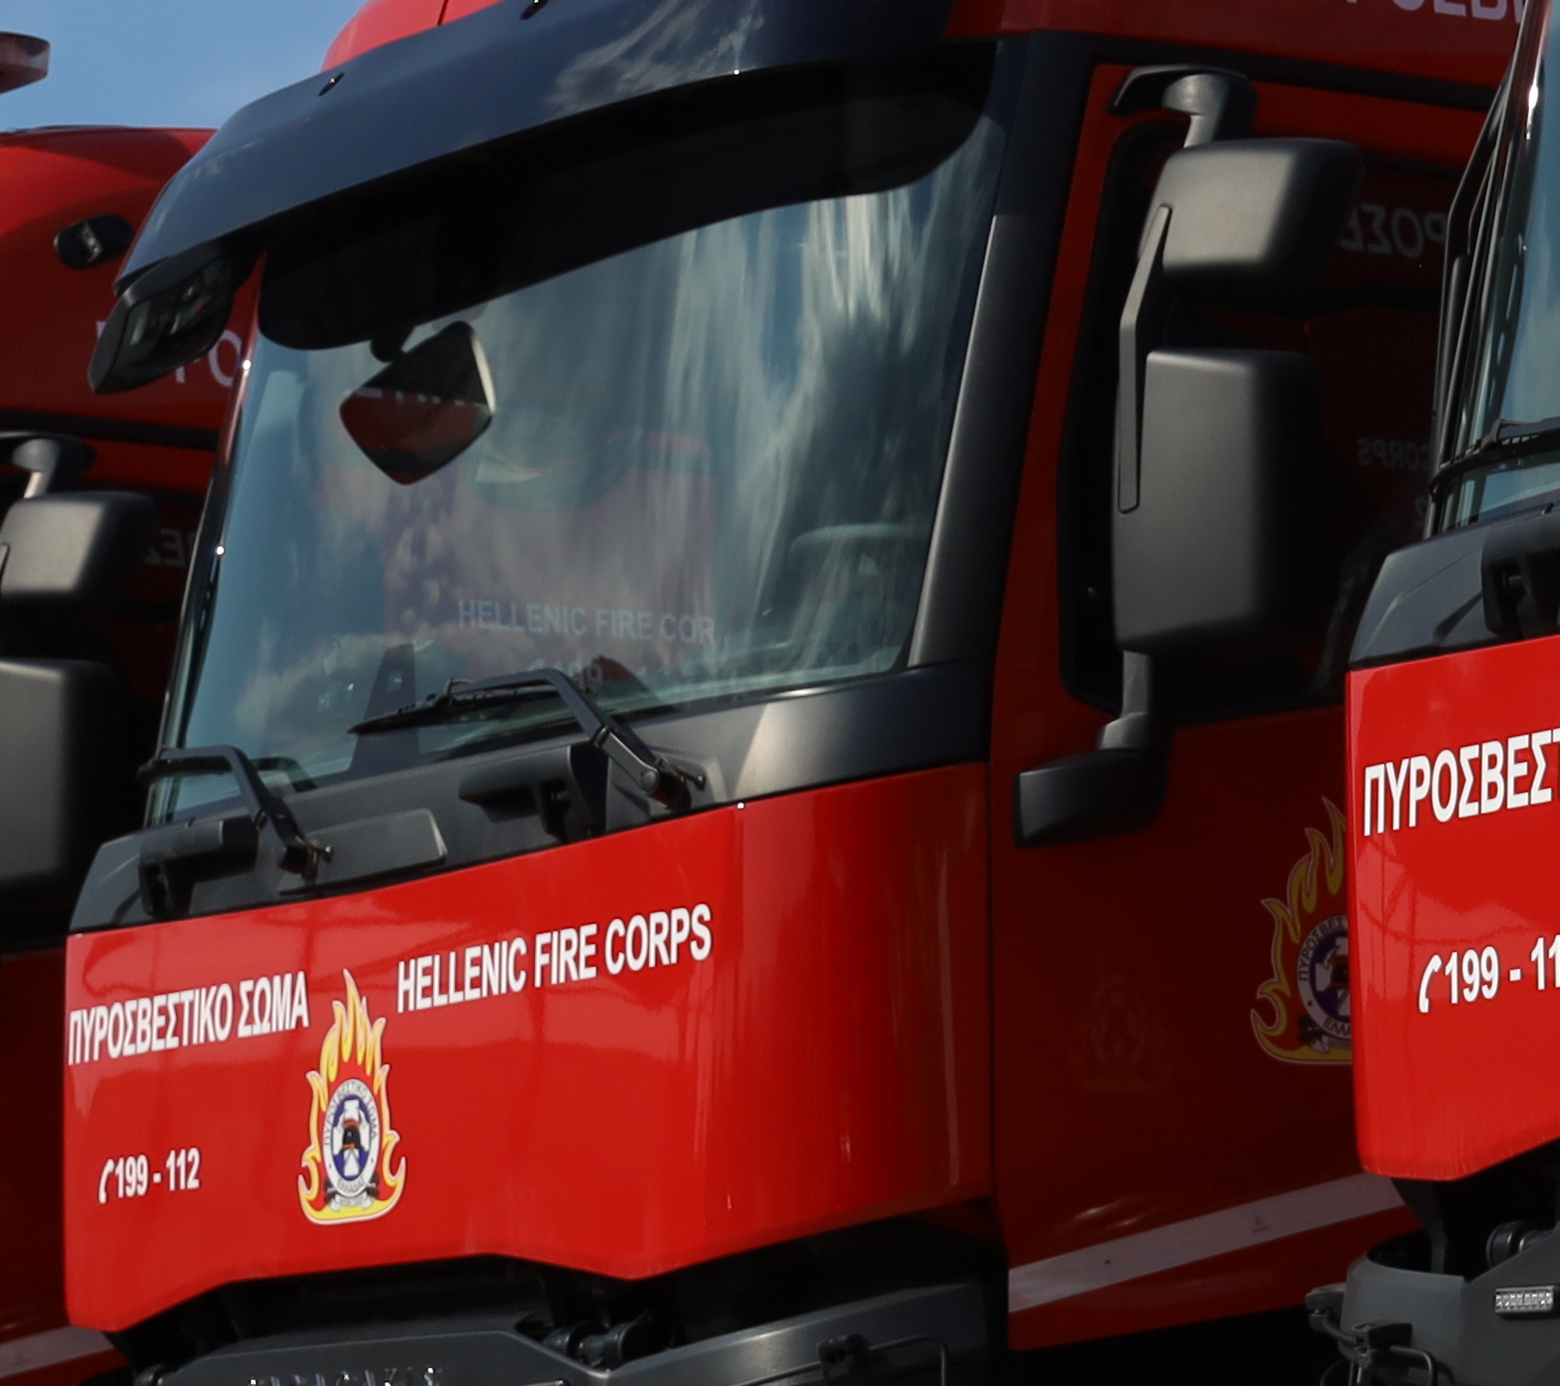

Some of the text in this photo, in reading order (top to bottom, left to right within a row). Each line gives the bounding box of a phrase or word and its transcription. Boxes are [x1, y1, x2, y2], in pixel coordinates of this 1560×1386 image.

[595, 608, 654, 641] FIRE
[397, 903, 712, 1013] HELLENIC FIRE CORPS
[1443, 945, 1501, 1006] 199
[68, 970, 309, 1066] ΠΥΡΟΣΒΕΣΤΙΚΟ ΣΩΜΑ
[114, 1153, 148, 1199] 199
[164, 1146, 201, 1192] 112
